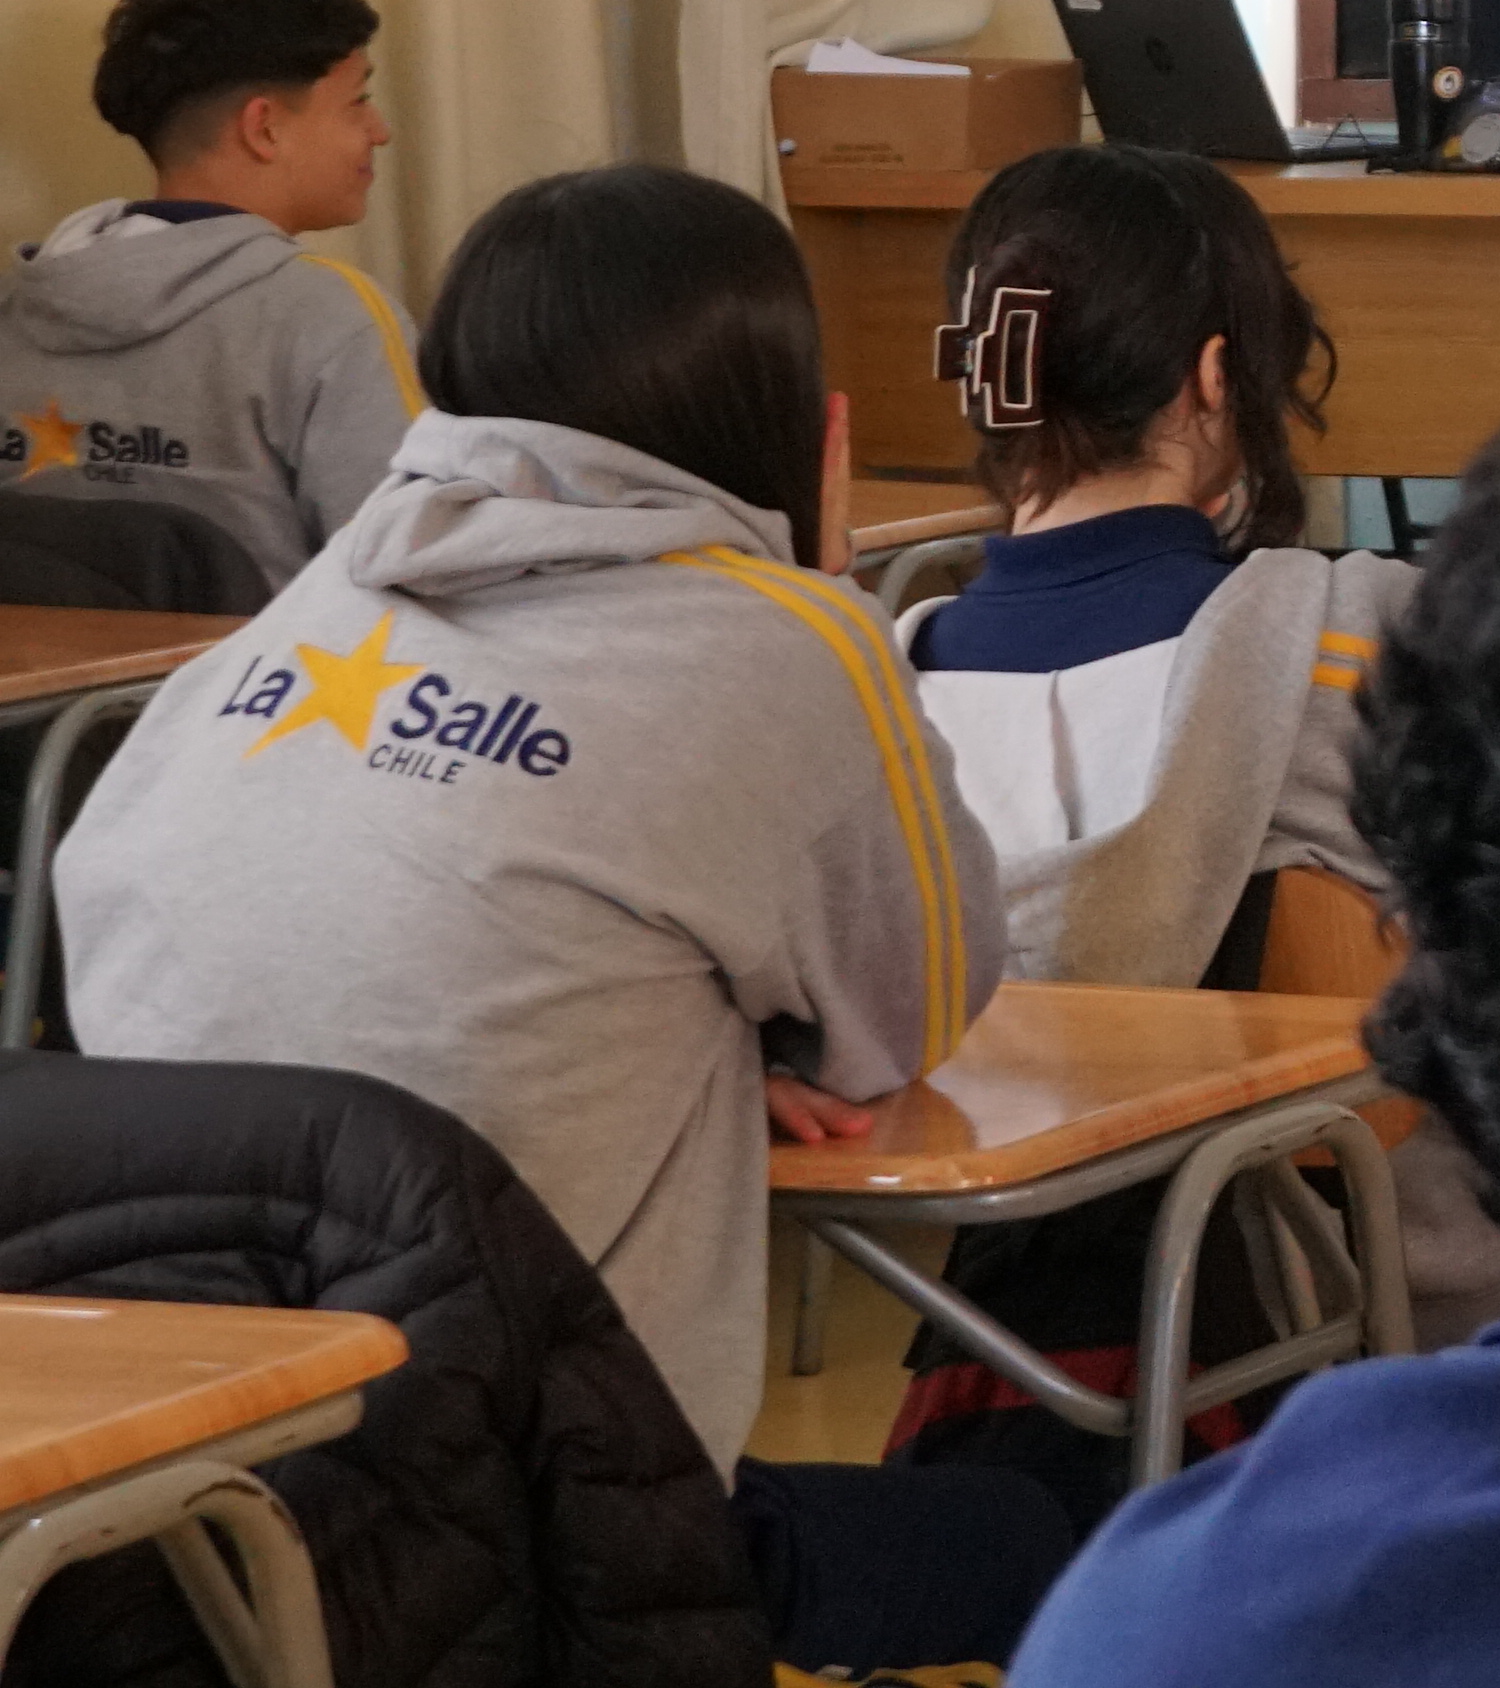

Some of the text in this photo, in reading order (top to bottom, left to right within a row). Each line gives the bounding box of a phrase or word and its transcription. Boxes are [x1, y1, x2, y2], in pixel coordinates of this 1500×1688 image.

[88, 420, 191, 469] Salle
[217, 654, 573, 777] La Salle
[367, 742, 468, 786] CHILE
